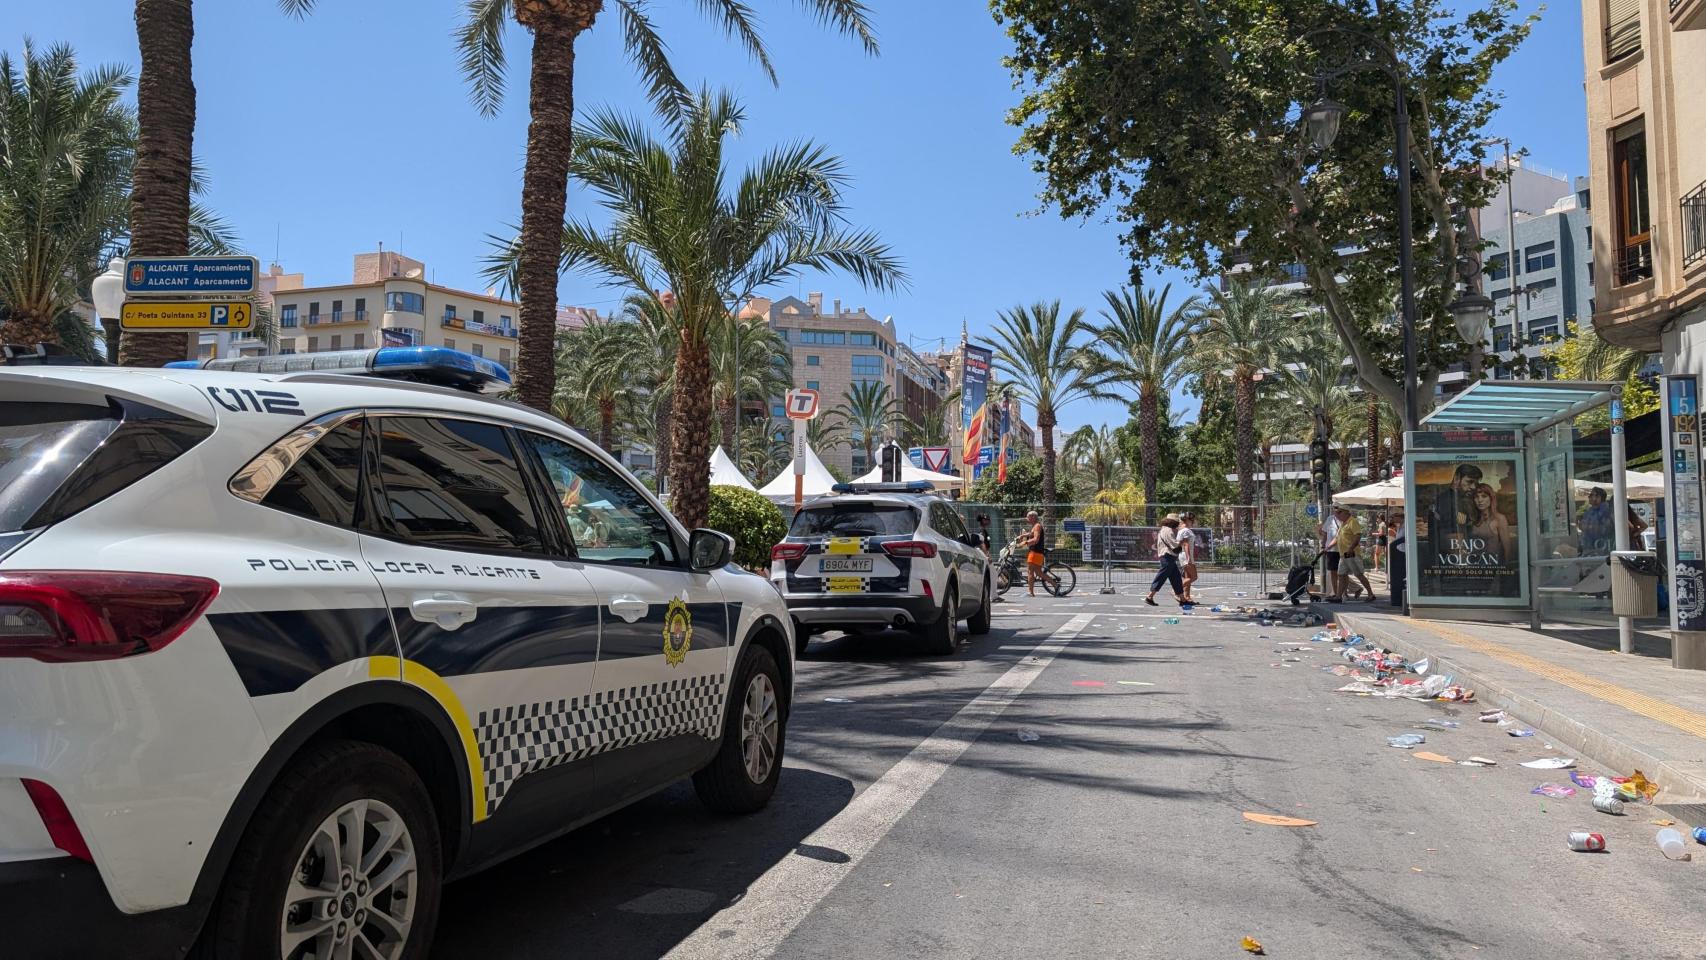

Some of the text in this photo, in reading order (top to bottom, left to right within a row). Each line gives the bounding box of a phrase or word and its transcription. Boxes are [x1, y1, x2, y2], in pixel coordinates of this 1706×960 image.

[148, 264, 251, 273] ALICANTE Aparcamientos
[148, 278, 249, 287] ALACANT Aparcaments
[125, 311, 207, 319] C/ Poeta Quintana 33
[213, 307, 227, 324] P
[1680, 380, 1686, 397] 1
[224, 387, 306, 416] 112
[795, 395, 812, 411] T
[1680, 397, 1689, 415] 5
[1673, 415, 1696, 432] 192
[797, 435, 805, 458] Luceros
[1450, 538, 1485, 553] BAJO
[1438, 552, 1499, 566] VOLCÁN
[368, 561, 445, 575] LOCAL
[451, 564, 541, 580] ALICANTE
